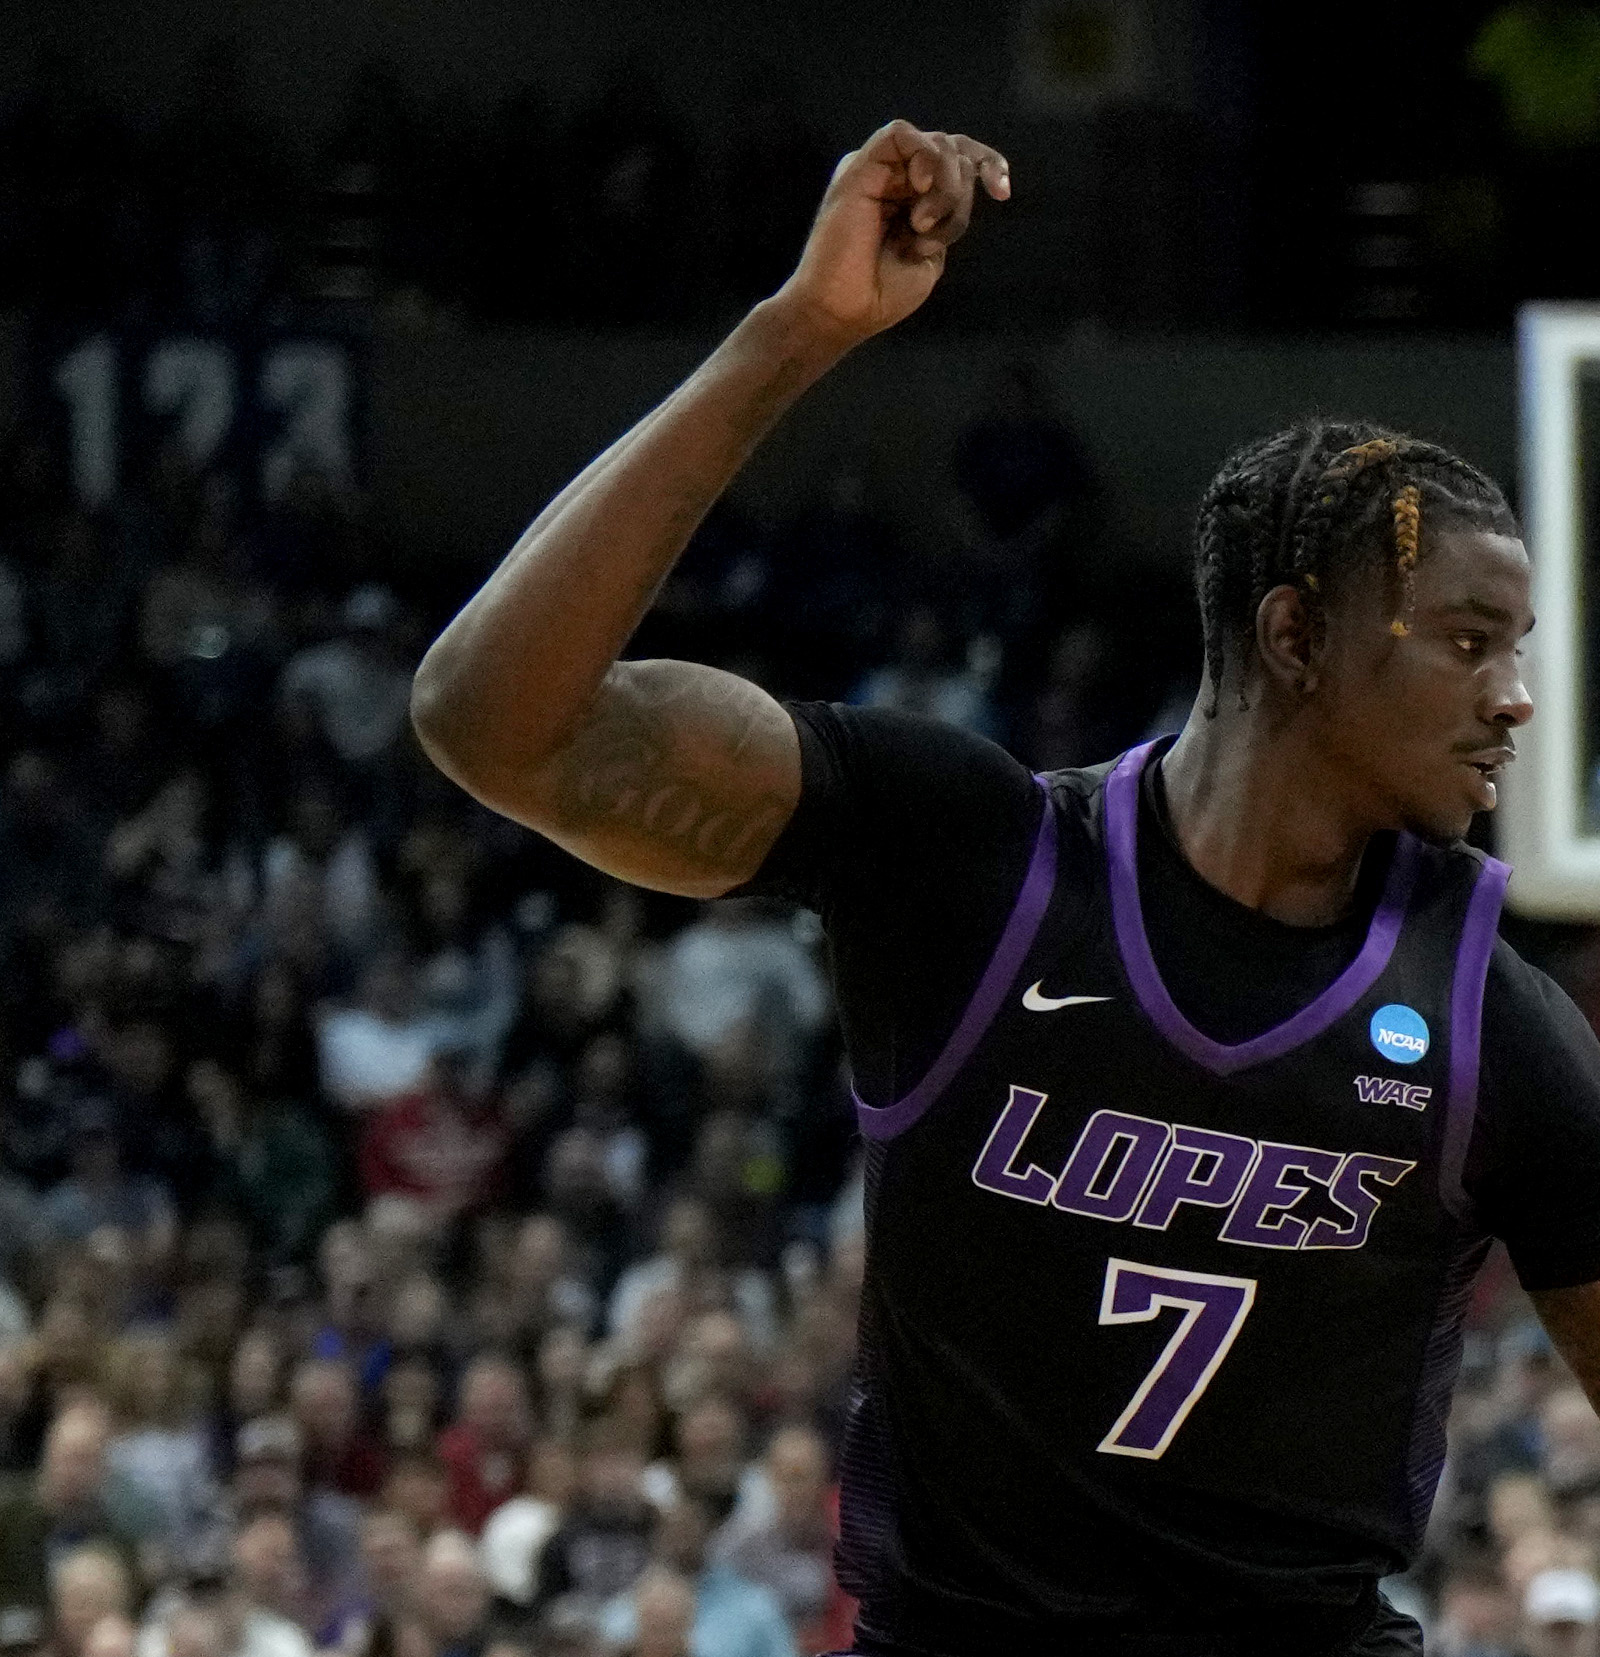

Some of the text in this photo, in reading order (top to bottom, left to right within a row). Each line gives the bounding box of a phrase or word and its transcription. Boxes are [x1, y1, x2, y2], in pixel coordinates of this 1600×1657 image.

[1377, 1028, 1426, 1054] NCAA
[1353, 1075, 1433, 1112] WAC
[971, 1083, 1418, 1250] LOPES
[1096, 1256, 1258, 1461] 7
